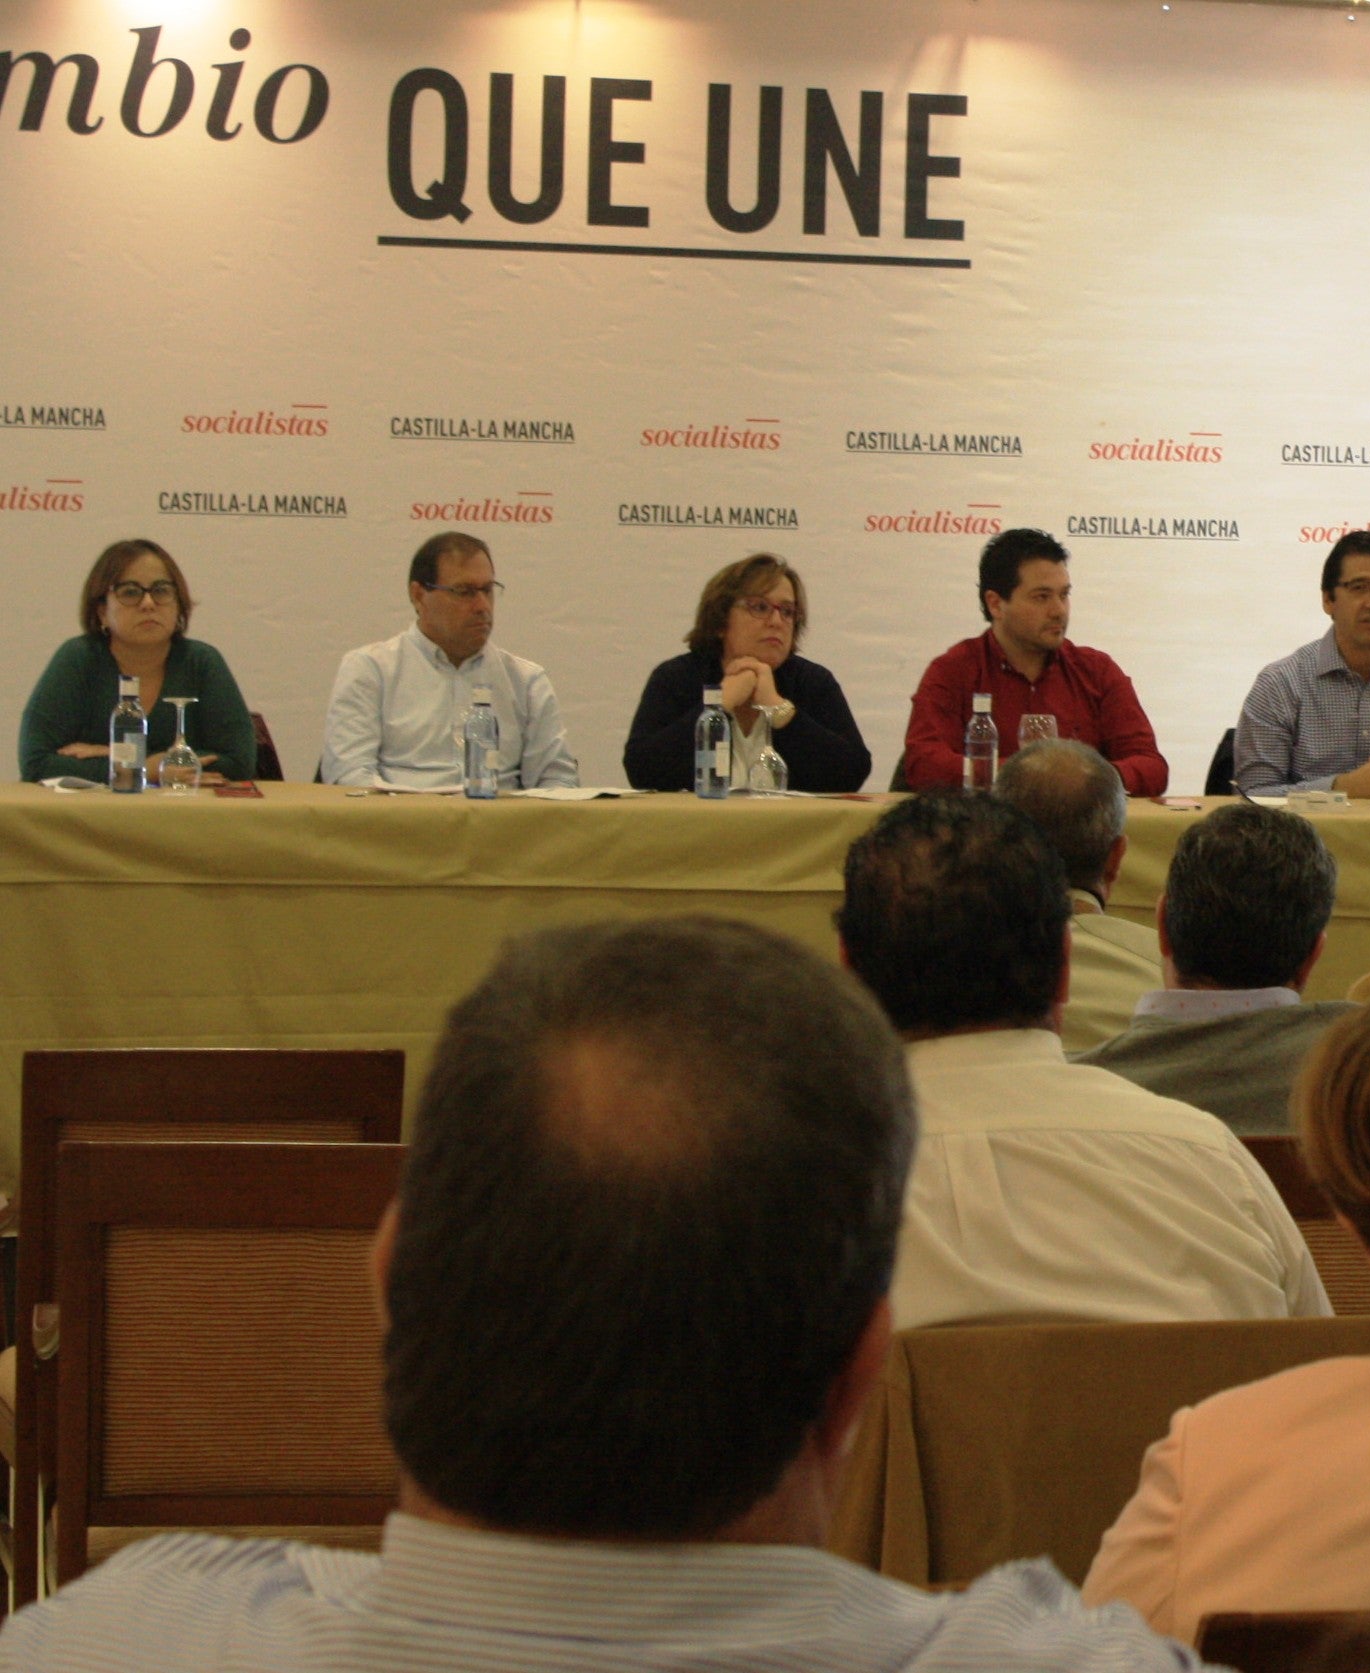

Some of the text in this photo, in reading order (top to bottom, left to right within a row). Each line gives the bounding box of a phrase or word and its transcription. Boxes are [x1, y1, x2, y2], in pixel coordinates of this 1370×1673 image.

[387, 67, 968, 241] QUE UNE
[0, 406, 107, 427] LA MANCHA
[181, 409, 329, 437] socialistas
[390, 417, 575, 441] CASTILLA-LA MANCHA
[640, 424, 781, 451] socialistas
[846, 431, 1023, 455] CASTILLA-LA MANCHA
[1088, 437, 1223, 464] socialistas
[158, 491, 348, 515] CASTILLA-LA MANCHA
[409, 497, 554, 524] socialistas
[618, 504, 799, 529] CASTILLA-LA MANCHA
[863, 509, 1001, 536] socialistas
[1067, 516, 1240, 538] CASTILLA-LA MANCHA
